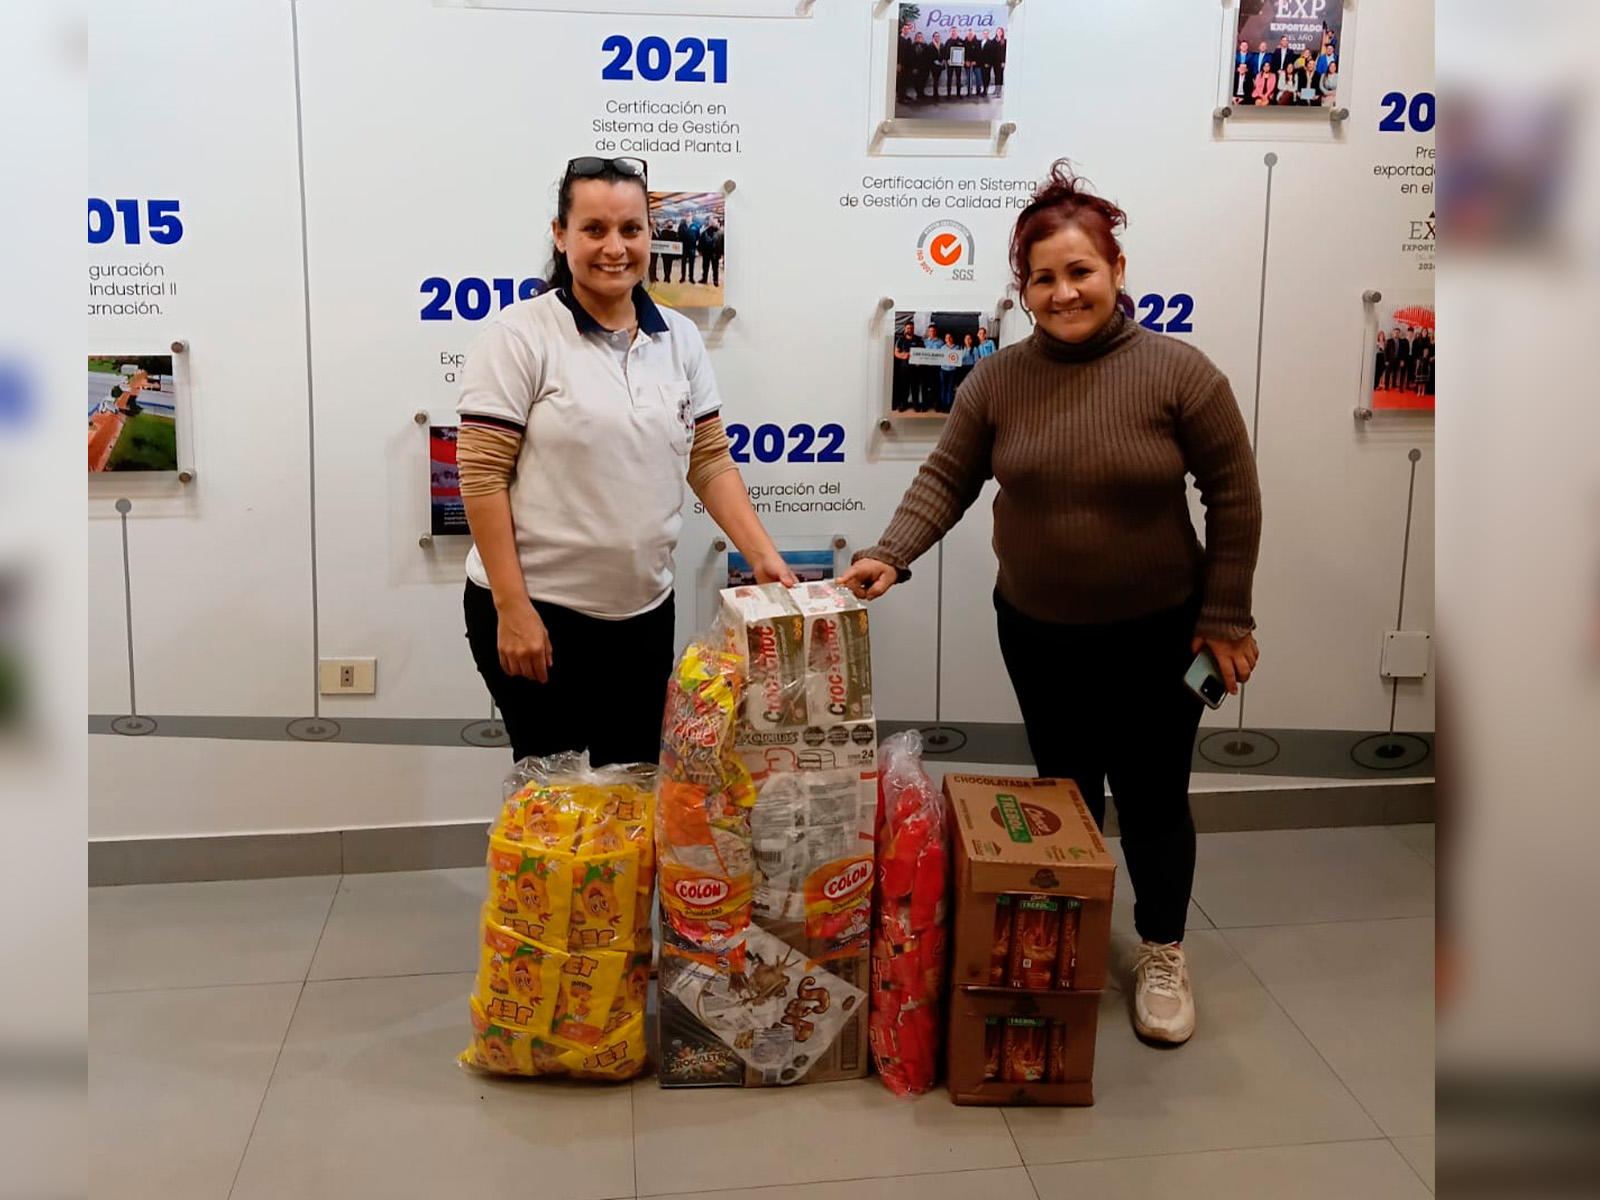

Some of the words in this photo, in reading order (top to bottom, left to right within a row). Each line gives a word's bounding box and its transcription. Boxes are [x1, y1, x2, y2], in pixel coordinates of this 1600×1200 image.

[1275, 0, 1326, 19] EXP
[601, 35, 728, 83] 2021
[606, 100, 703, 114] Certificación
[707, 105, 727, 115] en
[592, 118, 654, 133] Sistema
[658, 120, 678, 133] de
[682, 120, 740, 134] Gestión
[595, 138, 616, 151] de
[620, 138, 680, 152] Calidad
[684, 139, 732, 153] Planta
[862, 176, 954, 190] Certificación
[958, 179, 976, 191] en
[980, 178, 1038, 191] Sistema
[1401, 183, 1418, 194] en
[1421, 182, 1434, 194] el
[839, 194, 858, 207] de
[862, 194, 918, 207] Gestión
[922, 195, 941, 208] de
[945, 195, 1001, 208] Calidad
[952, 269, 974, 280] SGS
[90, 281, 165, 296] Industrial
[445, 372, 455, 382] a
[726, 424, 845, 463] 2022
[819, 482, 841, 495] del
[775, 498, 866, 513] Encarnación.
[828, 863, 867, 896] COLON
[680, 884, 721, 899] COLON
[487, 997, 534, 1026] JET
